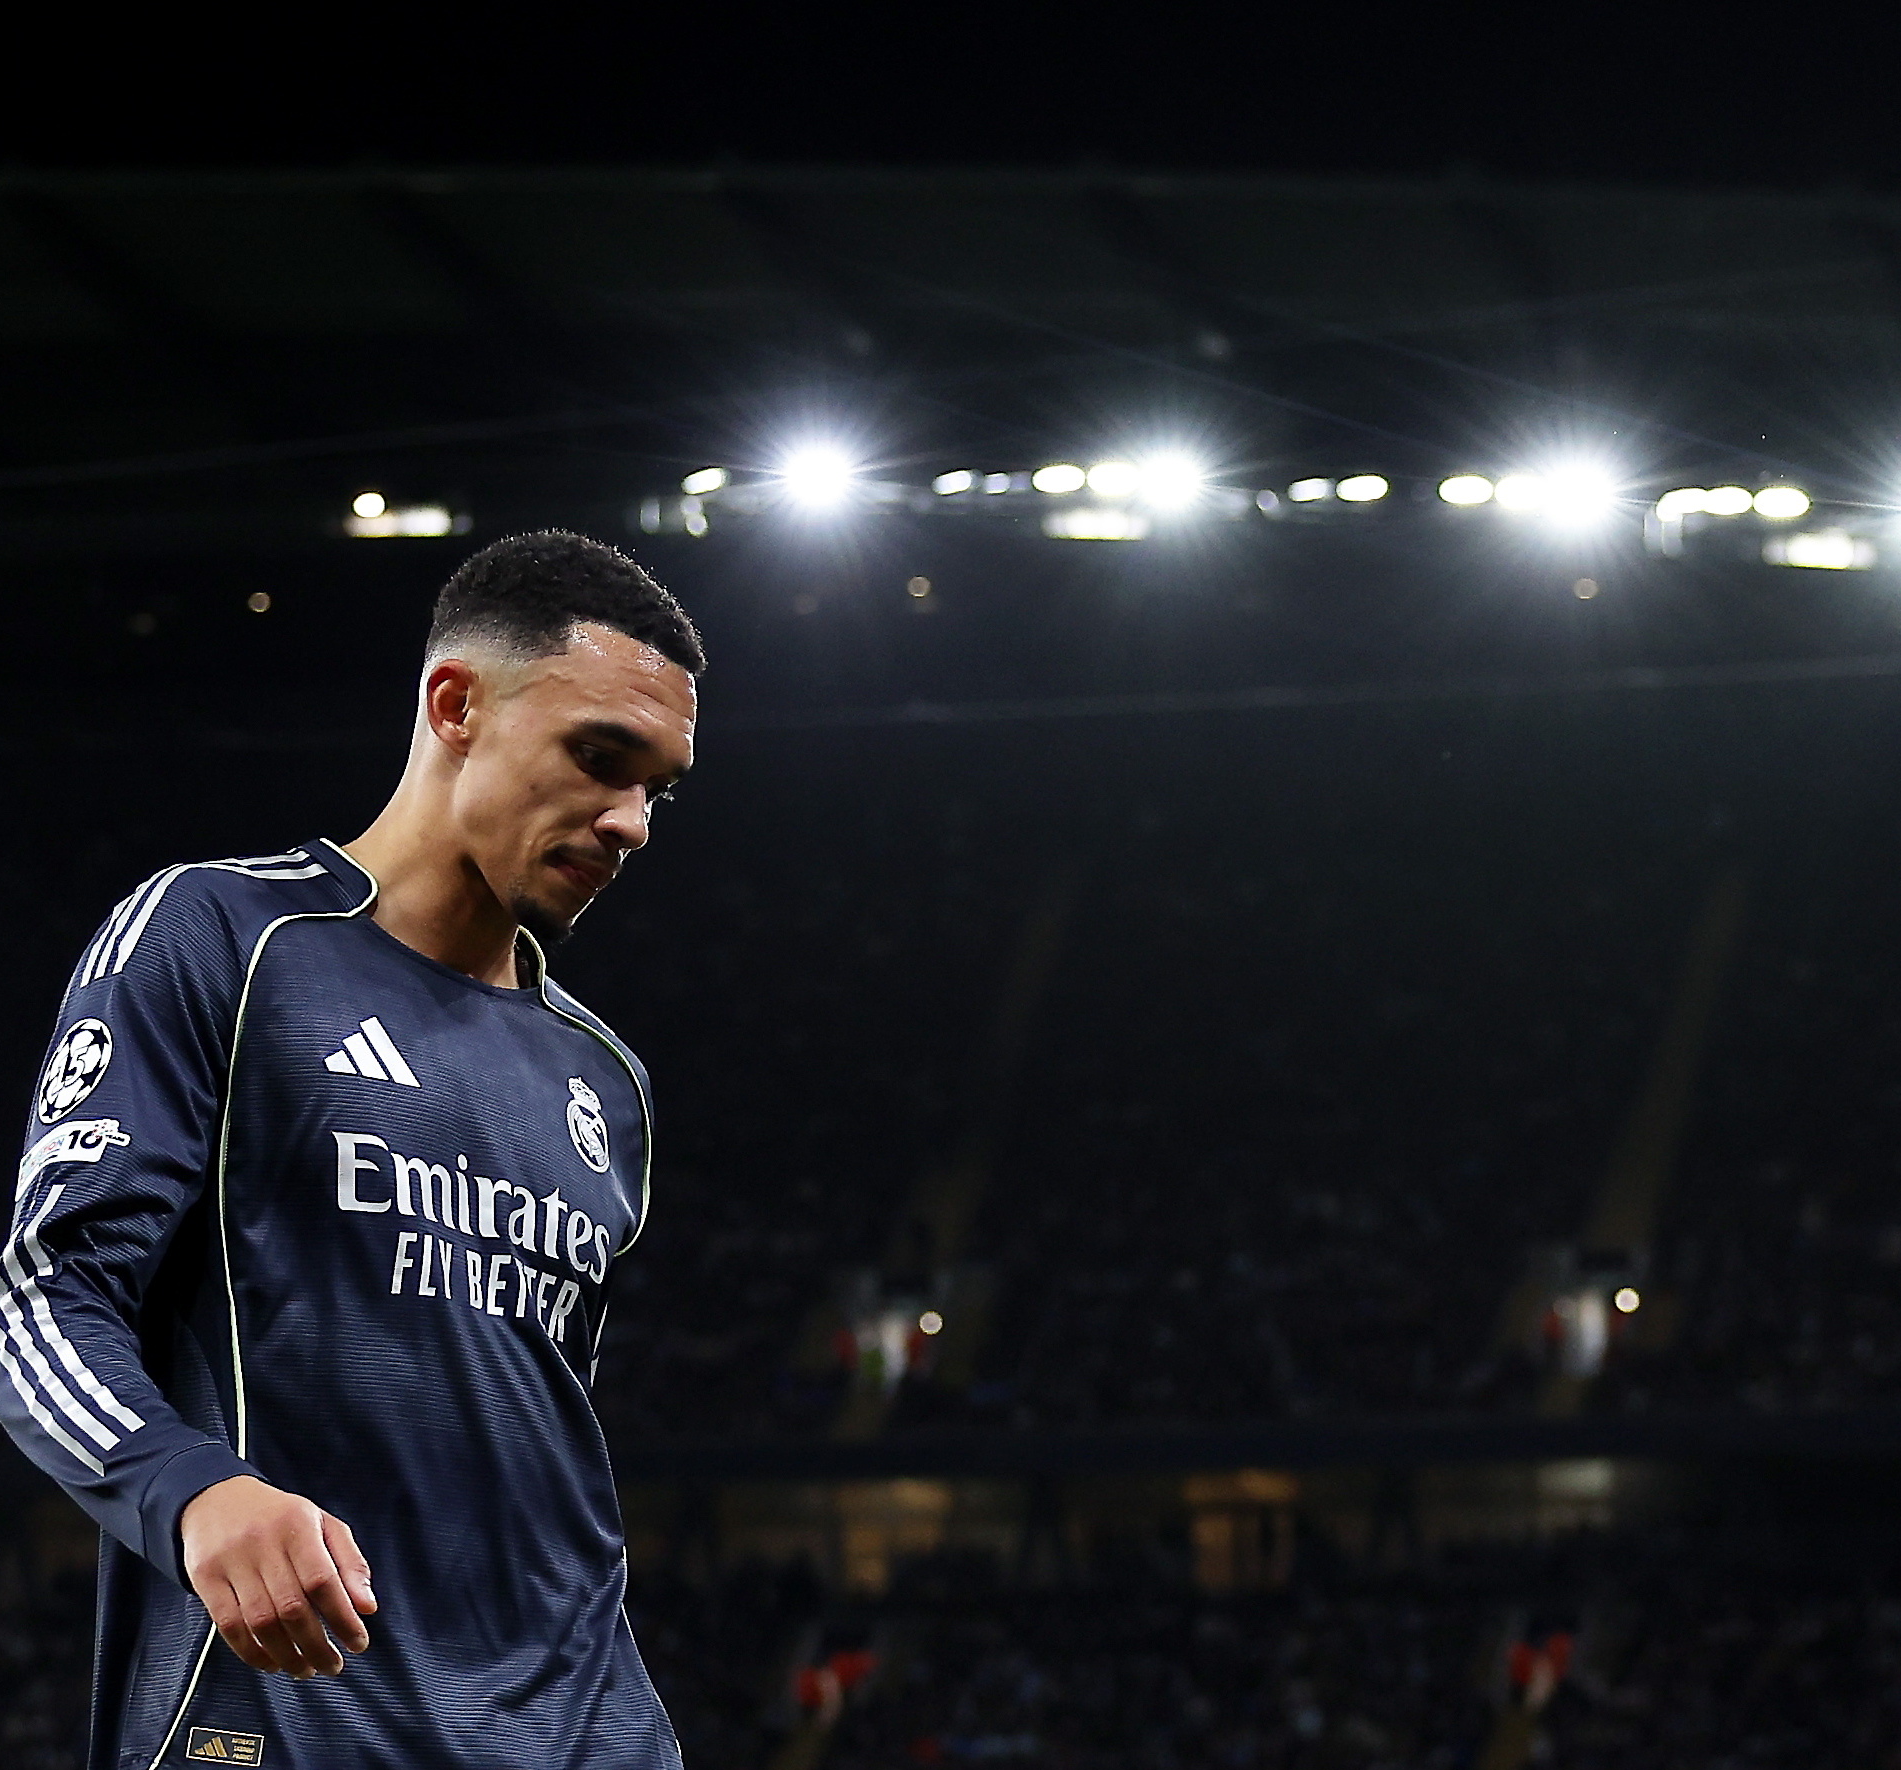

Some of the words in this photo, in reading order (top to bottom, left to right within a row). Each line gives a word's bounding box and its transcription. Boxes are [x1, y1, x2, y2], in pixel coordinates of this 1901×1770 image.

[331, 1130, 610, 1285] Emirates
[391, 1231, 454, 1300] FLY
[466, 1249, 580, 1343] BETTER
